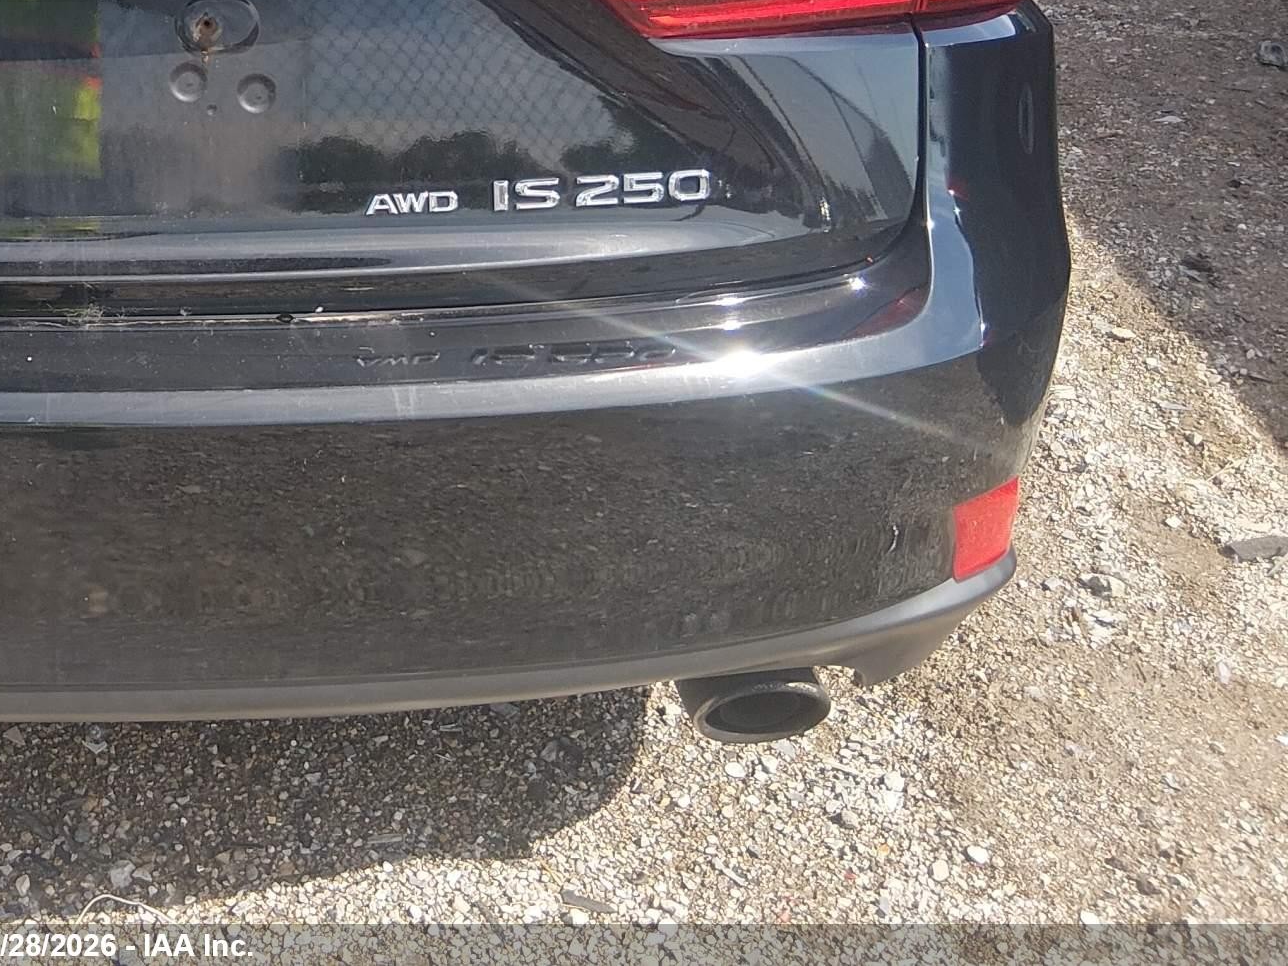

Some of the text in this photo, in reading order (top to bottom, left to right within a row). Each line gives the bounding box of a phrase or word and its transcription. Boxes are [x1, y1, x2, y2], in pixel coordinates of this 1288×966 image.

[365, 168, 711, 216] AWD IS 250
